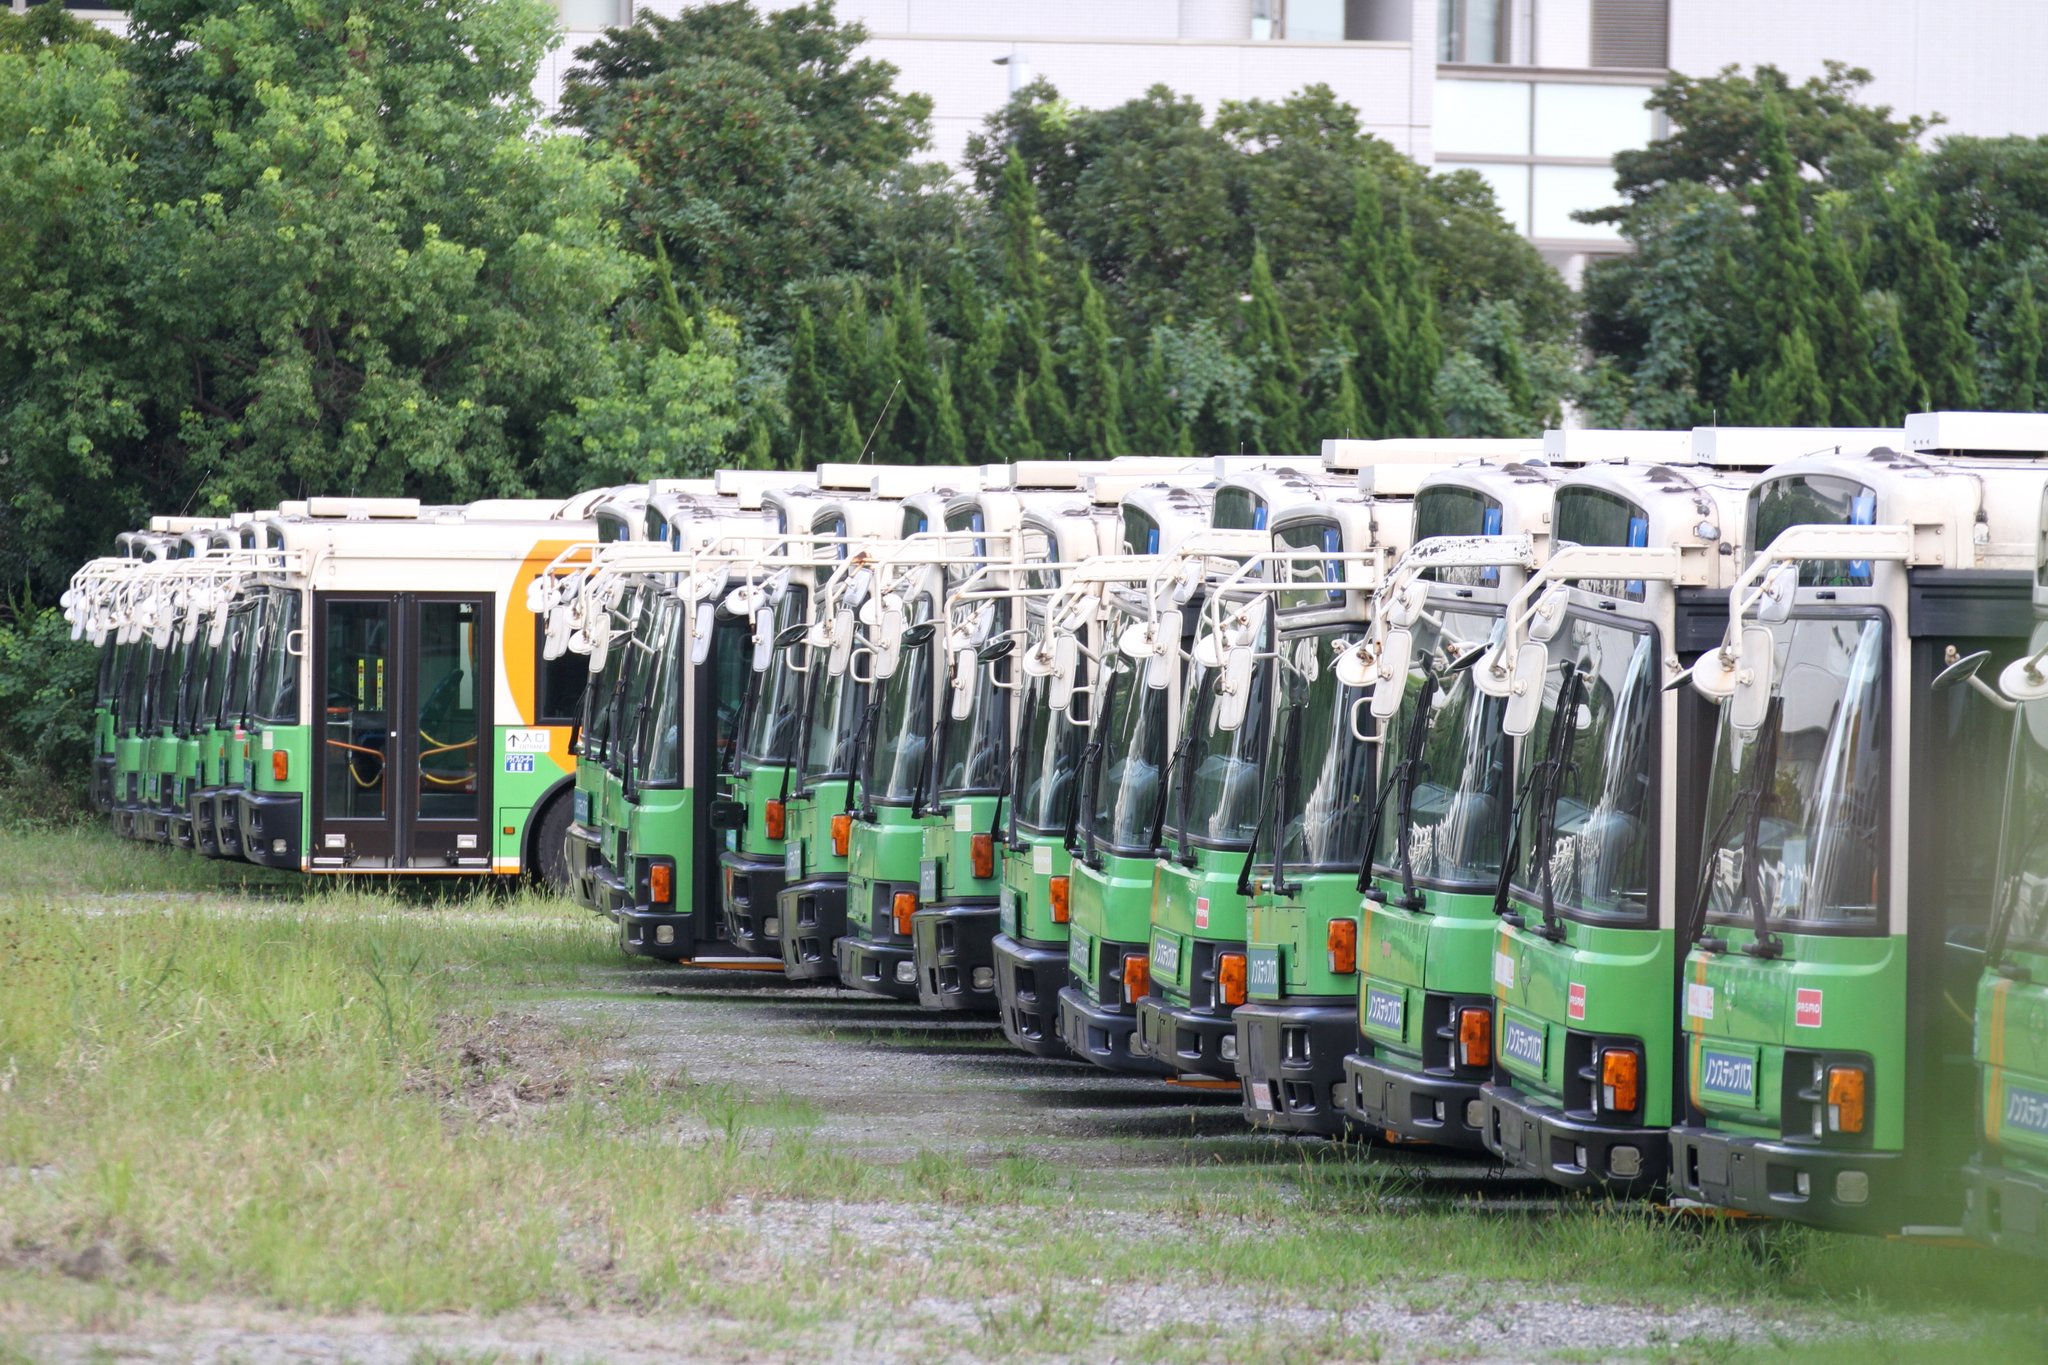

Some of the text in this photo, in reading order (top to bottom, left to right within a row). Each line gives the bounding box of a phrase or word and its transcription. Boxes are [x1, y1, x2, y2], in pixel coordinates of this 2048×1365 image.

[522, 732, 545, 743] 入口
[1368, 995, 1401, 1025] ノンステップバス
[1796, 1001, 1820, 1014] PASMO
[1505, 1025, 1541, 1064] ノンステップバス
[1704, 1058, 1752, 1091] ノンステップバス
